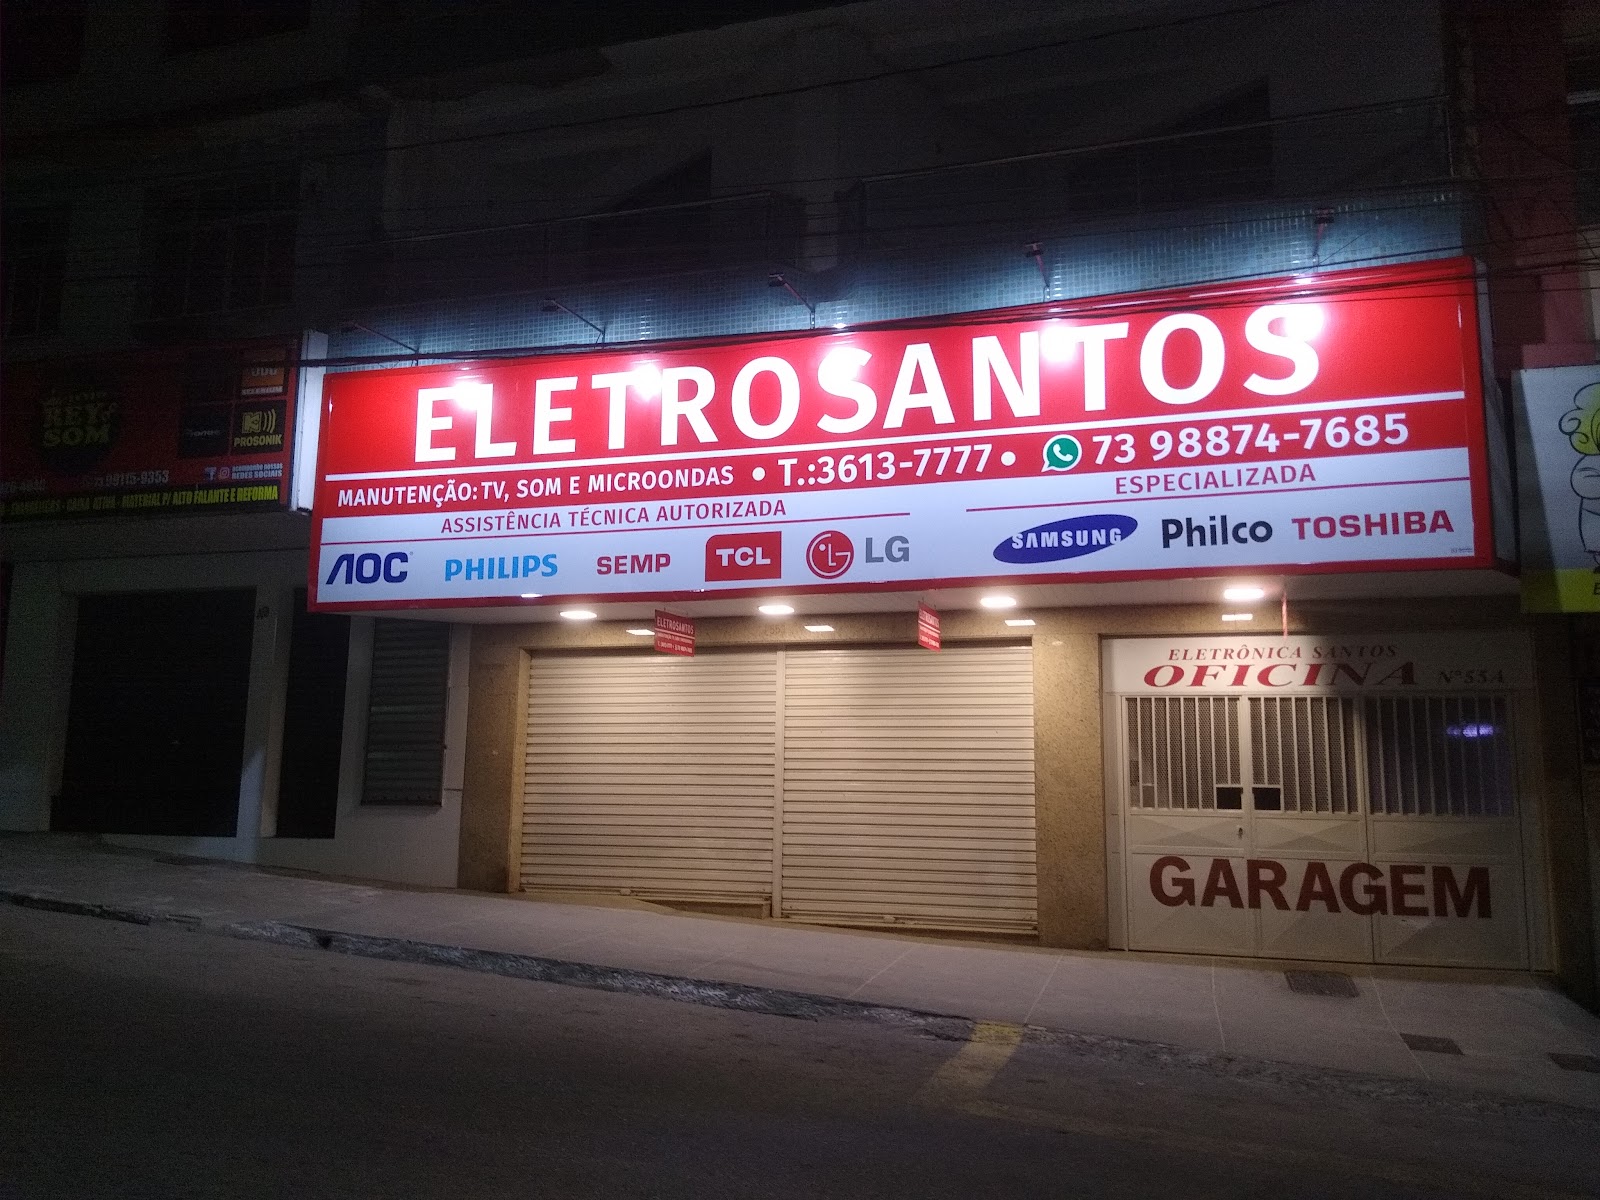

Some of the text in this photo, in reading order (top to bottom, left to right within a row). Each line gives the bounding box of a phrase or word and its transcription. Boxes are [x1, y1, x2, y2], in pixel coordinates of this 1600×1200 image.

[415, 303, 1325, 463] ELETROSANTOS
[233, 434, 283, 447] PROSONIK
[1092, 413, 1409, 465] 73 98874-7685
[338, 465, 734, 507] MANUTENÇÃO: TV, SOM E MICROONDAS
[1115, 463, 1316, 494] ESPECIALIZADA
[441, 500, 786, 533] ASSISTÊNCIA TÉCNICA AUTORIZADA
[1161, 515, 1273, 548] Philco
[1291, 510, 1455, 540] TOSHIBA
[865, 535, 910, 564] LG
[1011, 528, 1122, 550] SAMSUNG
[326, 552, 408, 585] AOC
[445, 554, 558, 581] PHILIPS
[596, 553, 671, 575] SEMP
[716, 547, 770, 567] TCL
[1168, 644, 1398, 661] ELETRÔNICA SANTOS
[1143, 662, 1418, 688] OFICINA
[1149, 855, 1493, 919] GARAGEM
